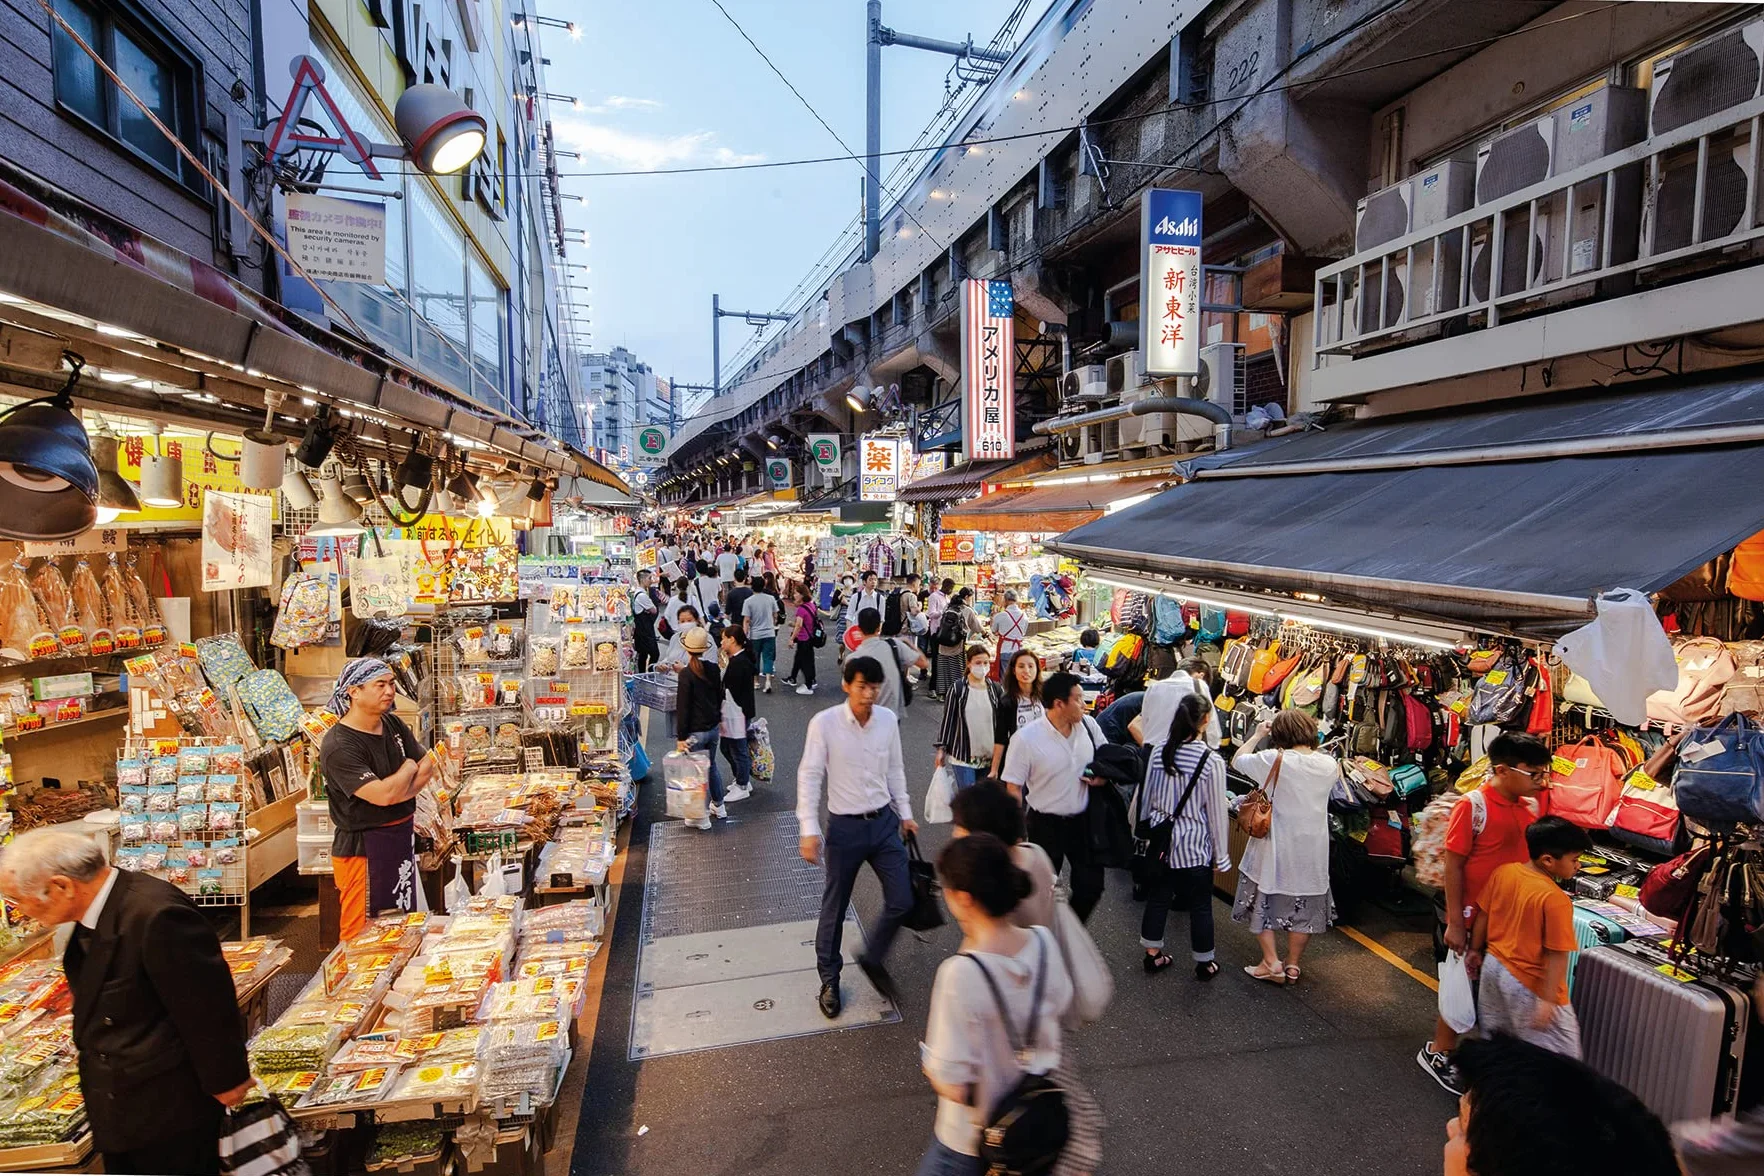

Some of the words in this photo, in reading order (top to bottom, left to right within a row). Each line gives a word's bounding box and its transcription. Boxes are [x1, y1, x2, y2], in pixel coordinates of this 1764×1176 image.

[1227, 51, 1260, 93] 222
[290, 225, 306, 233] This
[333, 231, 370, 241] monitored
[371, 234, 380, 242] by
[1154, 215, 1198, 237] Asahi
[303, 234, 332, 243] security
[334, 237, 367, 246] cameras.
[1155, 245, 1197, 256] アサヒビール
[1161, 267, 1186, 349] 新東洋
[982, 326, 1000, 424] アメリカ屋
[982, 441, 1002, 452] 610
[866, 441, 892, 472] 薬
[864, 476, 894, 486] タイコク
